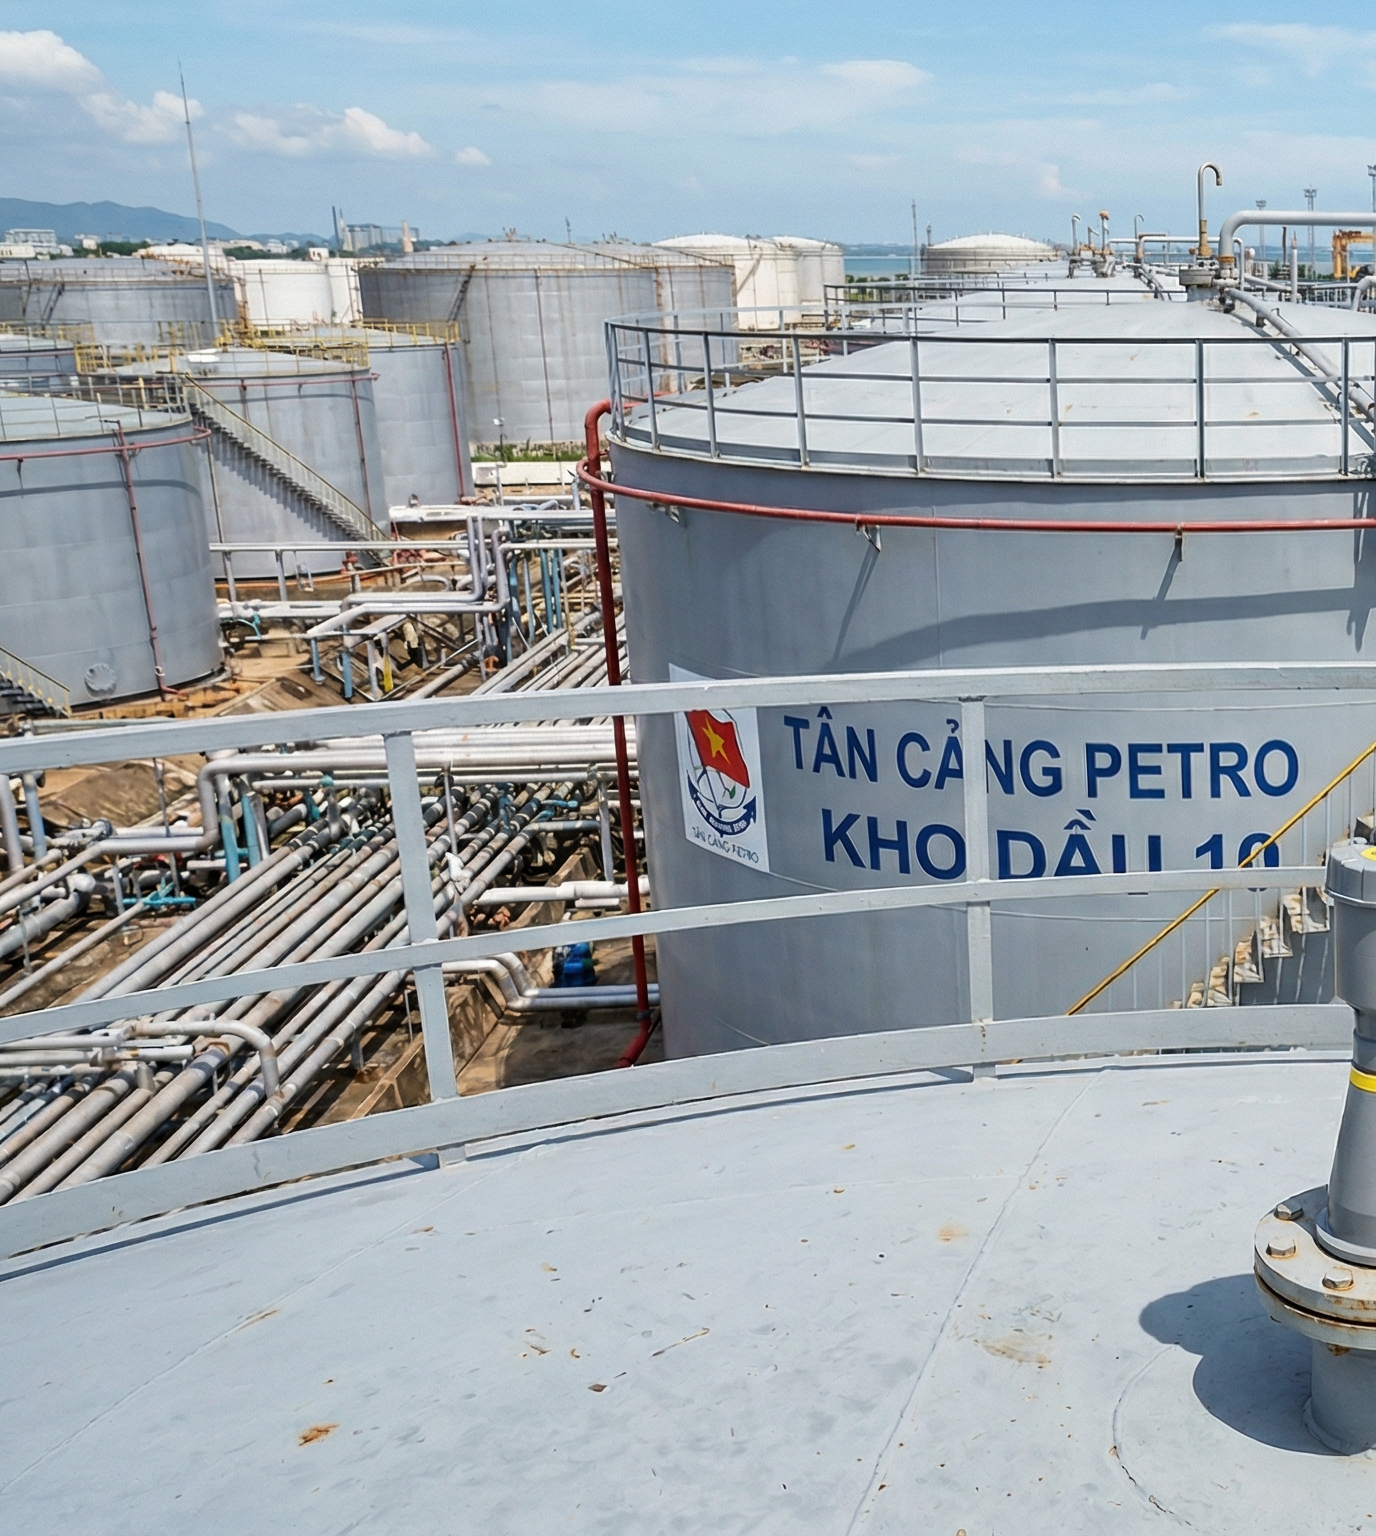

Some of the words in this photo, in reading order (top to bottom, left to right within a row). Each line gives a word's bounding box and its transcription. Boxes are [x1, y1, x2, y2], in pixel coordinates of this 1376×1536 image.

[784, 706, 878, 783] TÂN
[896, 718, 1063, 797] CẢNG
[1085, 739, 1299, 799] PETRO
[822, 808, 966, 880] KHO
[996, 809, 1162, 895] DẦU
